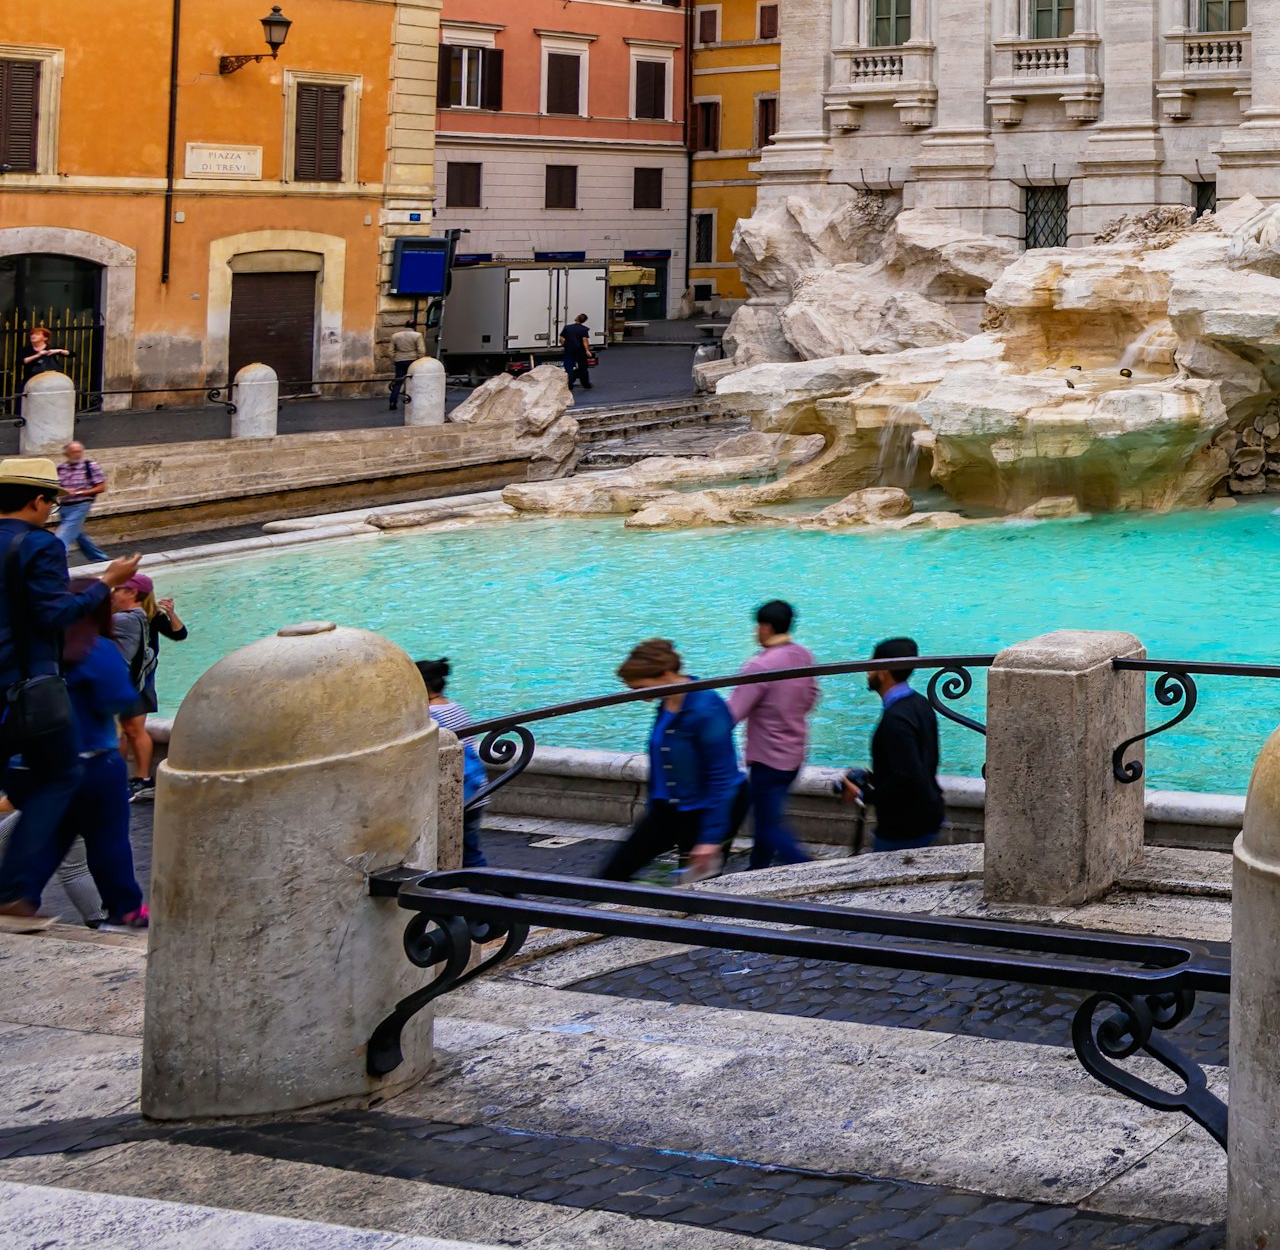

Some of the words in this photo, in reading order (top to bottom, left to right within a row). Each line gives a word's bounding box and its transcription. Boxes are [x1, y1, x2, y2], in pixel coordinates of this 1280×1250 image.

[208, 151, 242, 160] PIAZZA
[201, 163, 212, 171] DI
[216, 163, 246, 172] TREVI
